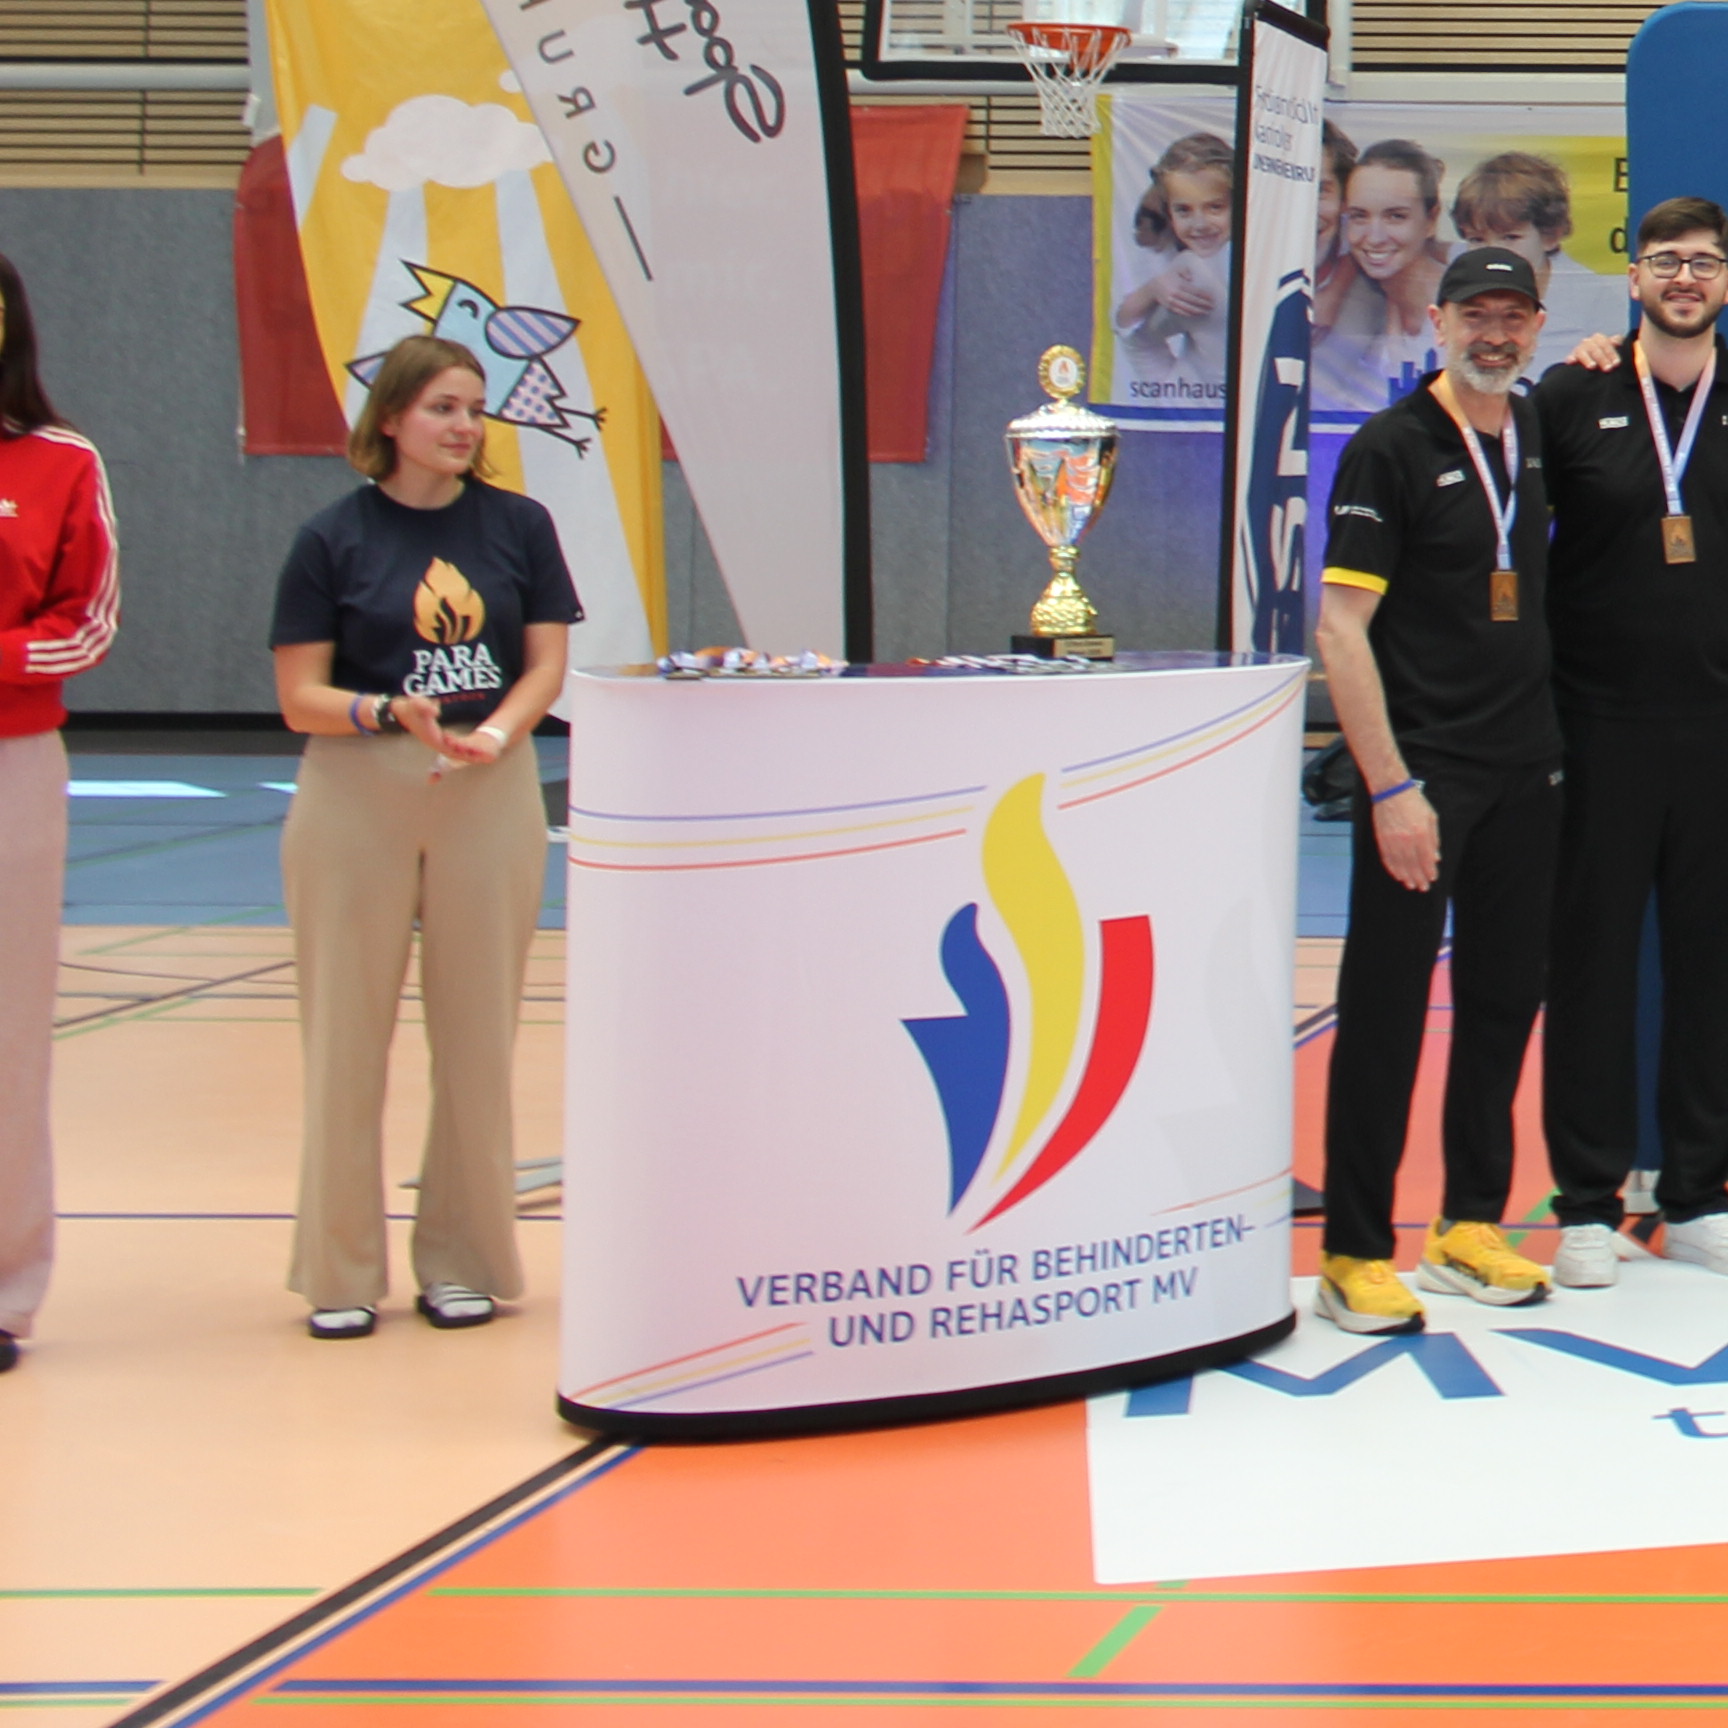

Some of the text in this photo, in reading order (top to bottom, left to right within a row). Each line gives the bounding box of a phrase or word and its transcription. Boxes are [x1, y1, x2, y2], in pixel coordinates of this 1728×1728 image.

[403, 665, 502, 698] GAMES
[413, 643, 494, 673] PARA
[737, 1212, 1256, 1308] VERBAND FÜR BEHINDERTEN-
[827, 1266, 1198, 1346] UND REHASPORT MV
